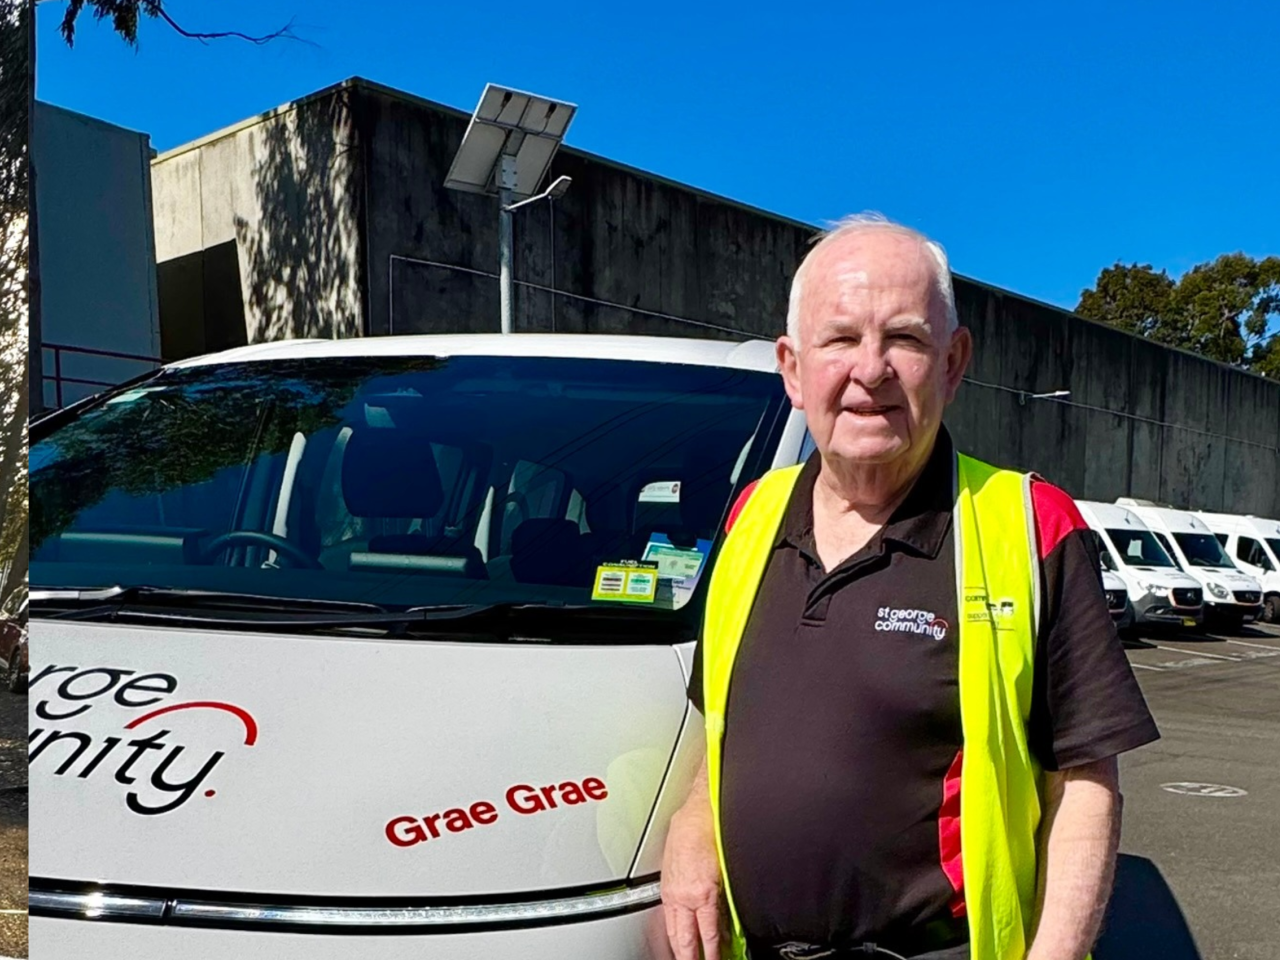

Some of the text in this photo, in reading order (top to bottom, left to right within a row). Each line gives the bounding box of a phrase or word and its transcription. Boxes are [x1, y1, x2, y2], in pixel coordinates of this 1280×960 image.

[874, 619, 946, 641] community
[877, 606, 935, 623] st george
[28, 728, 225, 816] nity.
[384, 776, 609, 848] Grae Grae
